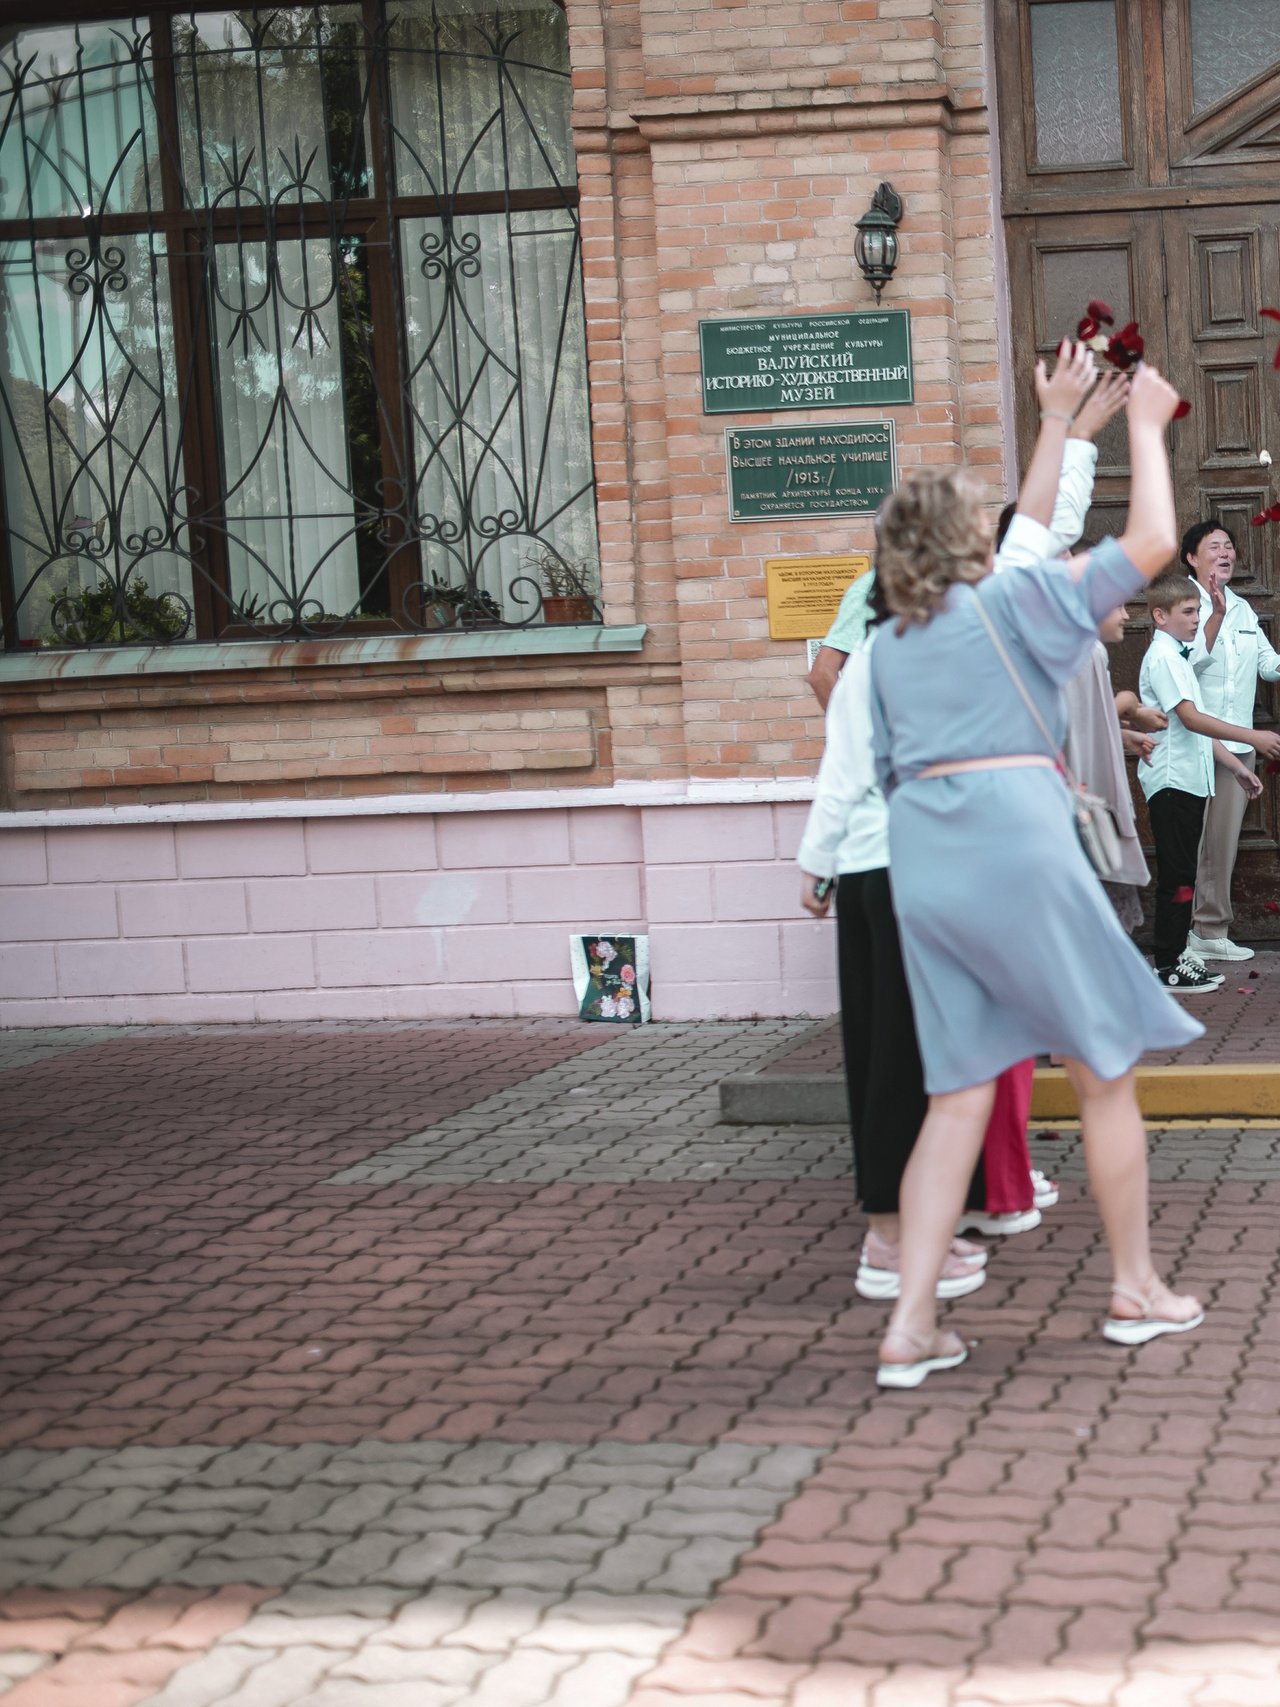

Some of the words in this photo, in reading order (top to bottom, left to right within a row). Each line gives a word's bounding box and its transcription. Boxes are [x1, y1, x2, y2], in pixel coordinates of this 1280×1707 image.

[768, 331, 840, 342] МУНИЦИПАЛЬНОЕ
[726, 345, 772, 355] БЮДЖЕТНОЕ
[782, 342, 835, 352] УЧРЕЖДЕНИЕ
[845, 340, 883, 349] КУЛЬТУРЫ
[757, 352, 854, 371] ВАЛУЙСКИЙ
[706, 365, 908, 390] ИСТОРИКО-ХУДОЖЕСТВЕННЫЙ
[780, 386, 835, 403] МУЗЕЙ
[733, 437, 740, 450] В
[743, 438, 772, 449] ЭТОМ
[775, 435, 815, 448] ЗДАНИИ
[819, 432, 889, 445] НАХОДИЛОСЬ
[733, 455, 773, 468] ВЫСШЕЕ
[778, 453, 837, 465] НАЧАЛЬНОЕ
[841, 451, 889, 463] УЧИЛИЩЕ
[740, 492, 777, 500] ПАМЯТНИК
[781, 489, 831, 498] АРХИТЕКТУРЫ
[835, 488, 862, 496] КОНЦА
[760, 502, 805, 511] ОХРАНЯЕТСЯ
[810, 499, 869, 508] ГОСУДАРСТВОМ
